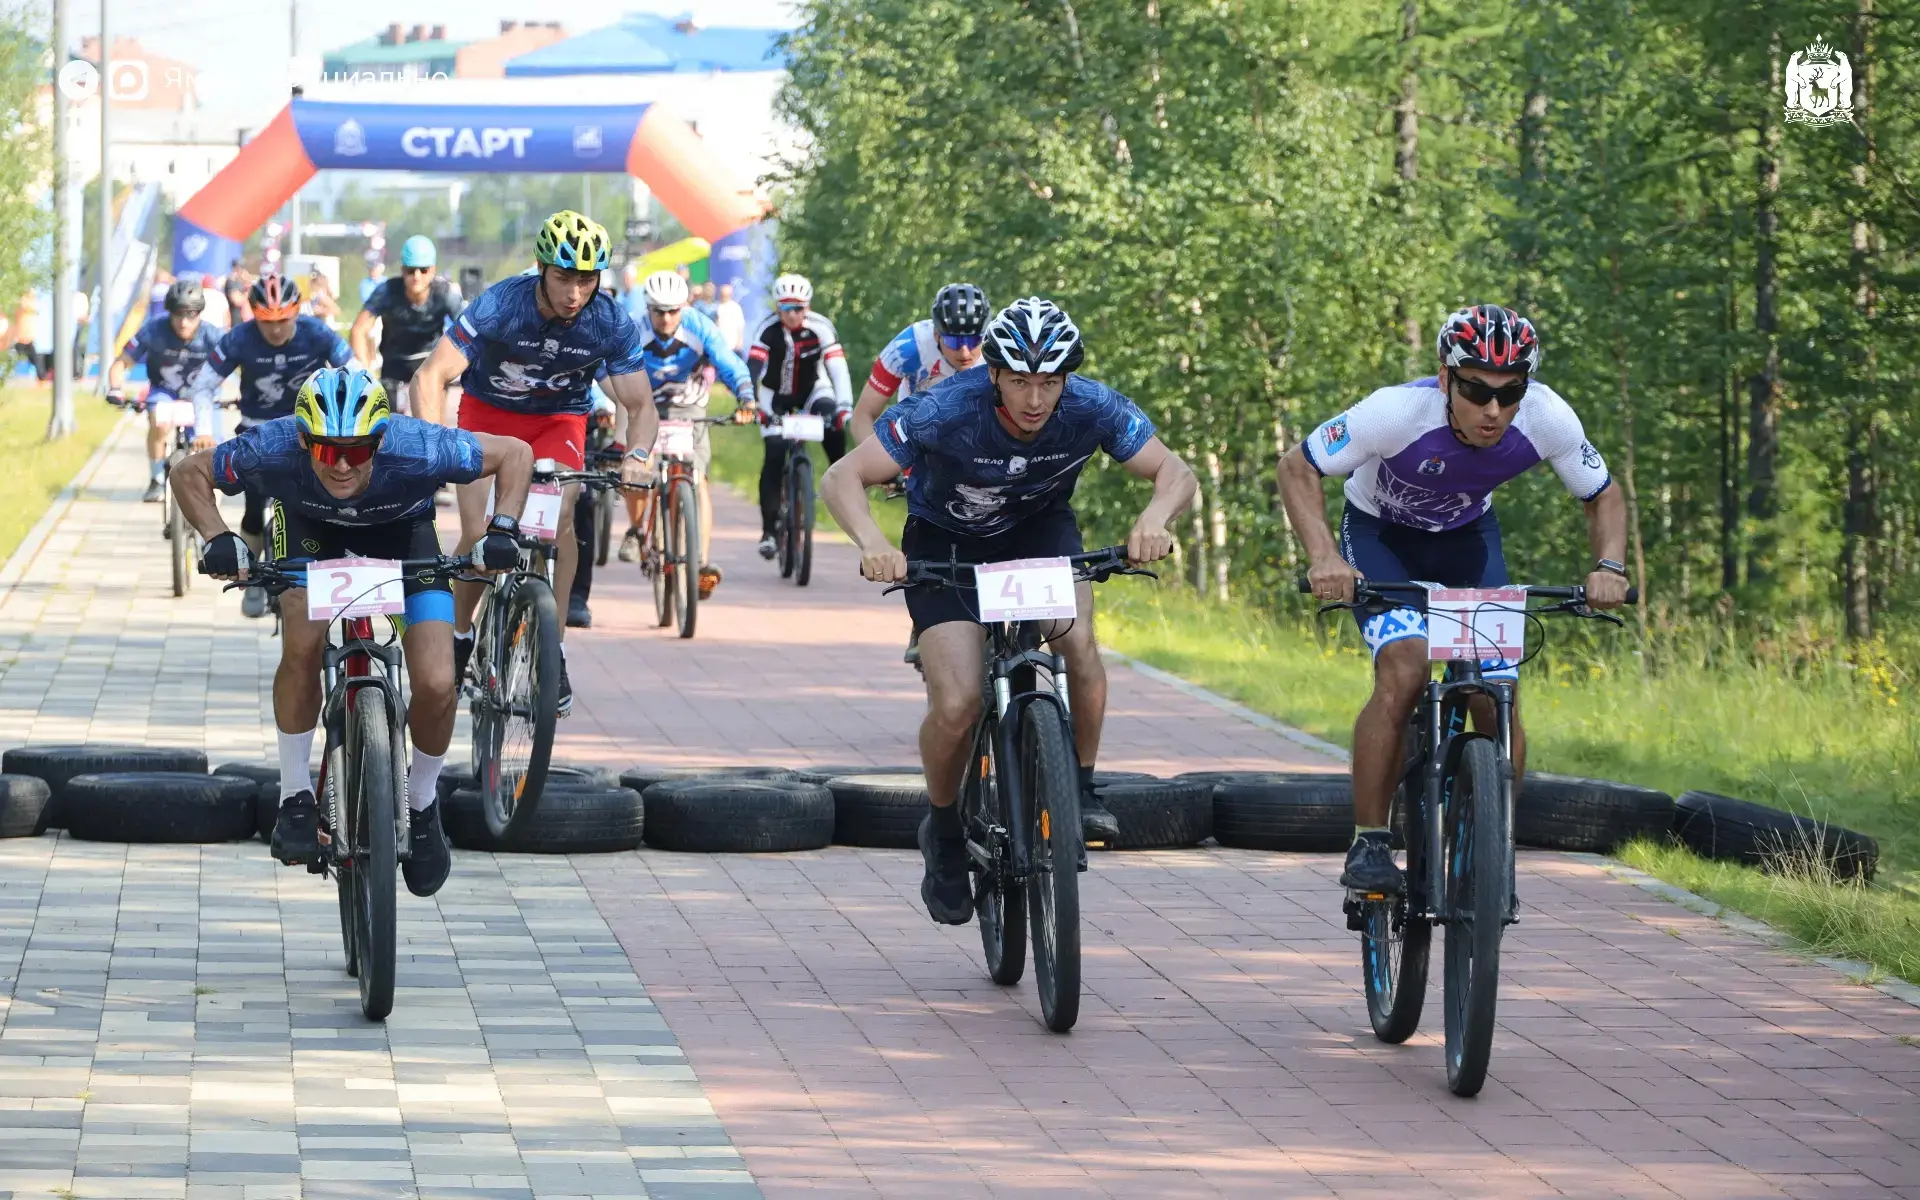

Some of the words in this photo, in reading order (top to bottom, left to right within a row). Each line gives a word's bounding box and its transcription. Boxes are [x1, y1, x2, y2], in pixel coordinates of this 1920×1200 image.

[401, 127, 533, 158] СТАРТ
[535, 510, 545, 526] 1
[330, 571, 354, 604] 2
[373, 583, 387, 601] 1
[1000, 574, 1024, 606] 4
[1043, 584, 1058, 604] 1
[1452, 606, 1476, 645] 1
[1496, 622, 1508, 644] 1
